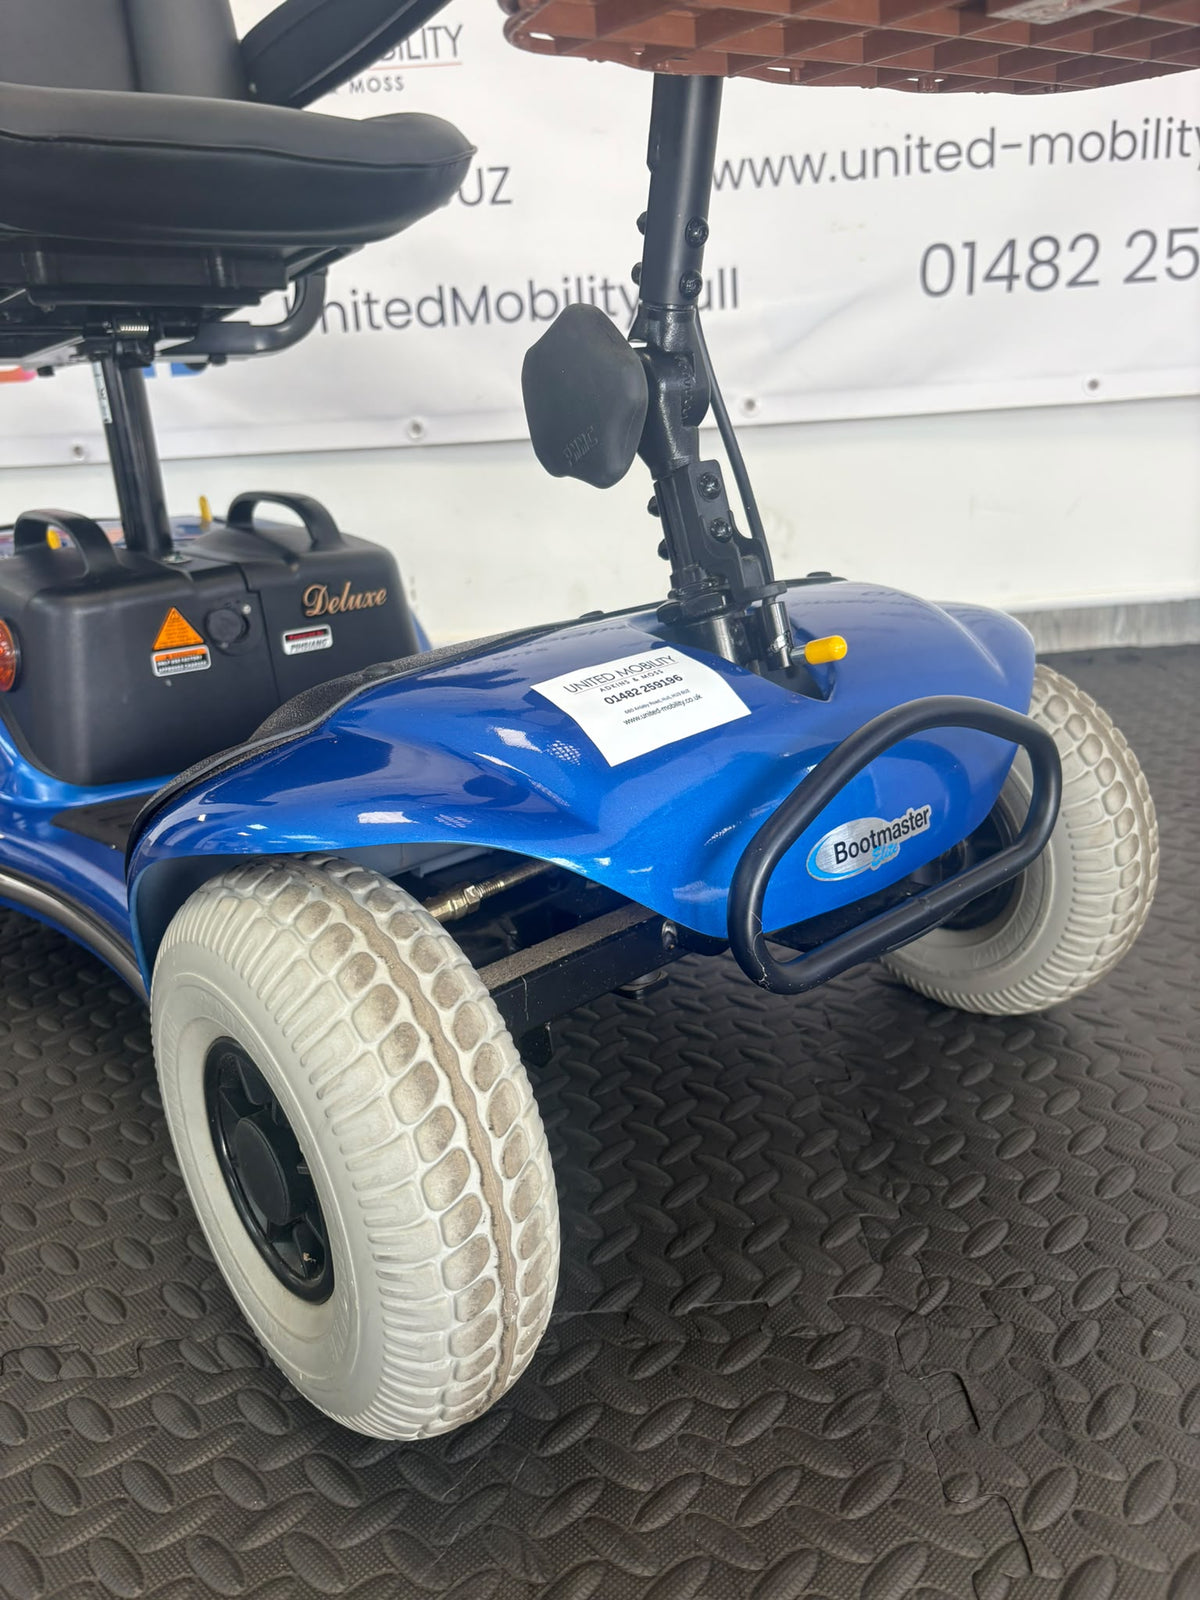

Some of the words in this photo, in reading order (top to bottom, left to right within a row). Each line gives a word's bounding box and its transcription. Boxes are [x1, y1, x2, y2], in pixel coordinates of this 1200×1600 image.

[349, 76, 404, 94] MOSS
[919, 232, 1100, 298] 01482
[1122, 226, 1200, 284] 25
[303, 581, 387, 617] Deluxe
[563, 672, 616, 694] UNITED
[615, 655, 676, 679] MOBILITY
[599, 680, 631, 693] ADKINS
[641, 669, 664, 680] MOSS
[603, 688, 642, 705] 01482
[640, 674, 683, 694] 259196
[834, 808, 929, 865] Bootmaster
